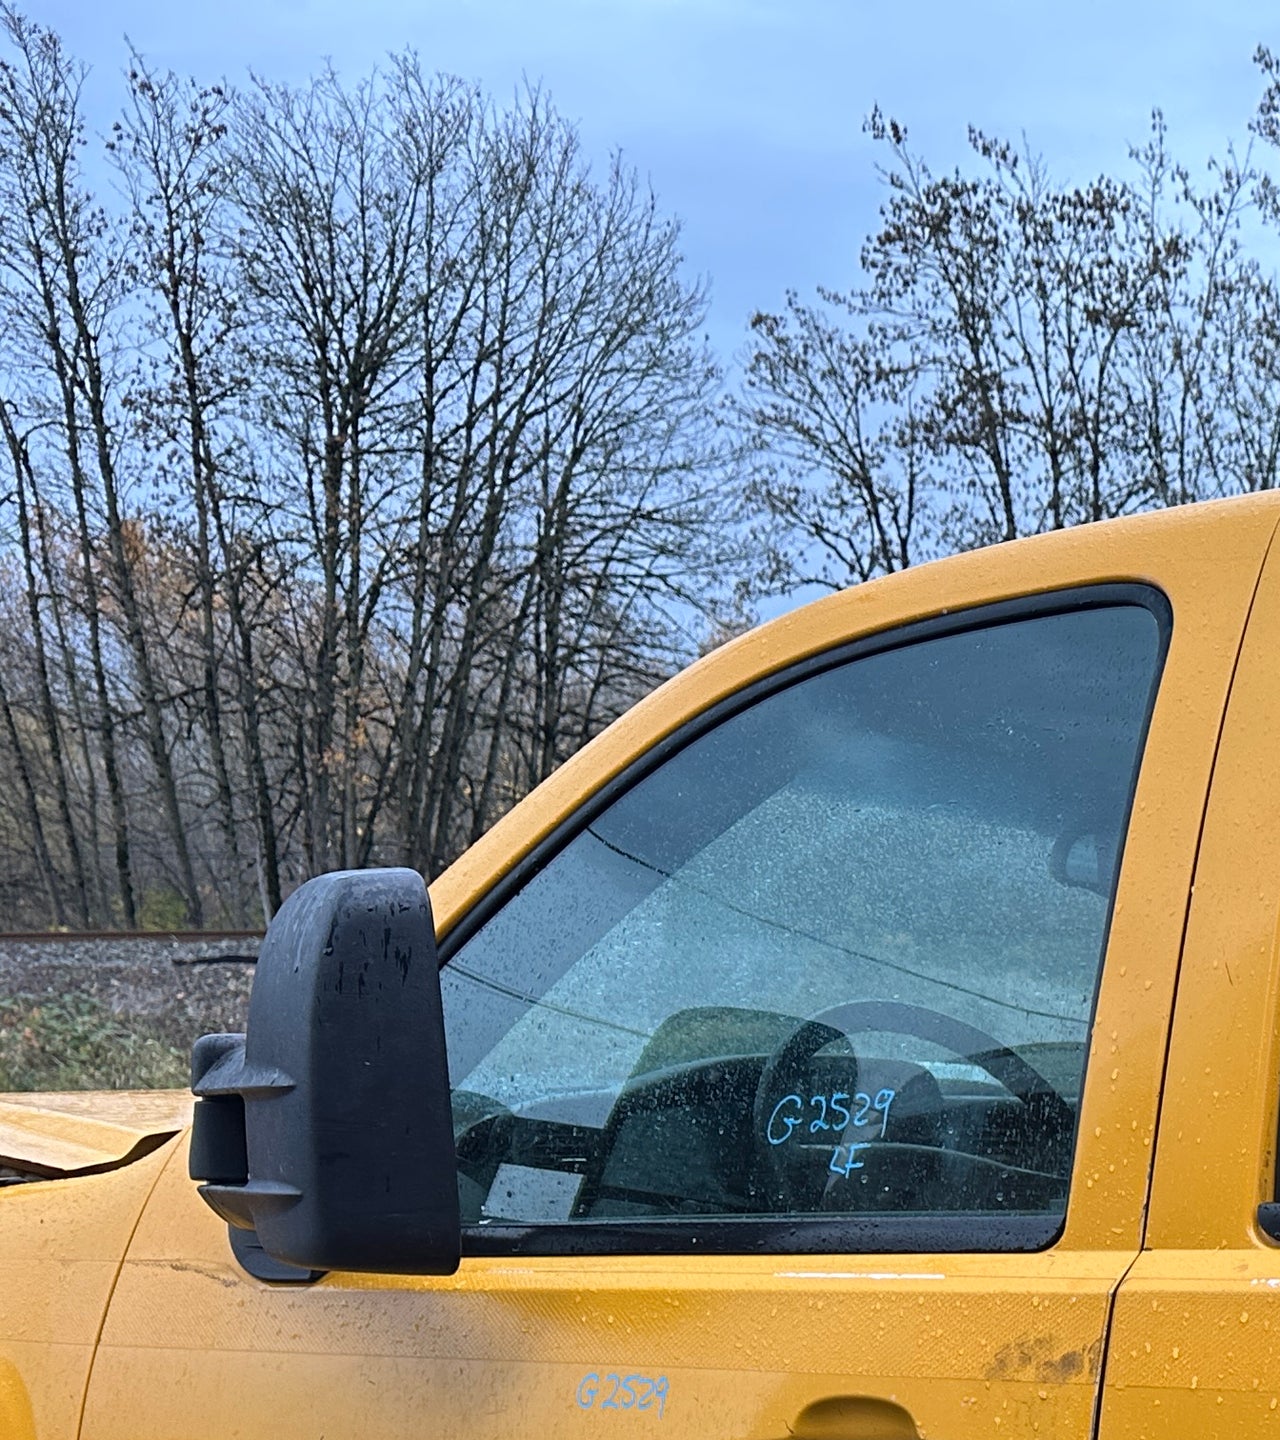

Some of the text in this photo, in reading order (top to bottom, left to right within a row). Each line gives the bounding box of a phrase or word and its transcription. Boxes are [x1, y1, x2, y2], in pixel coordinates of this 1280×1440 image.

[767, 1088, 895, 1145] G2529
[830, 1142, 871, 1179] LF
[577, 1373, 669, 1420] G2529
